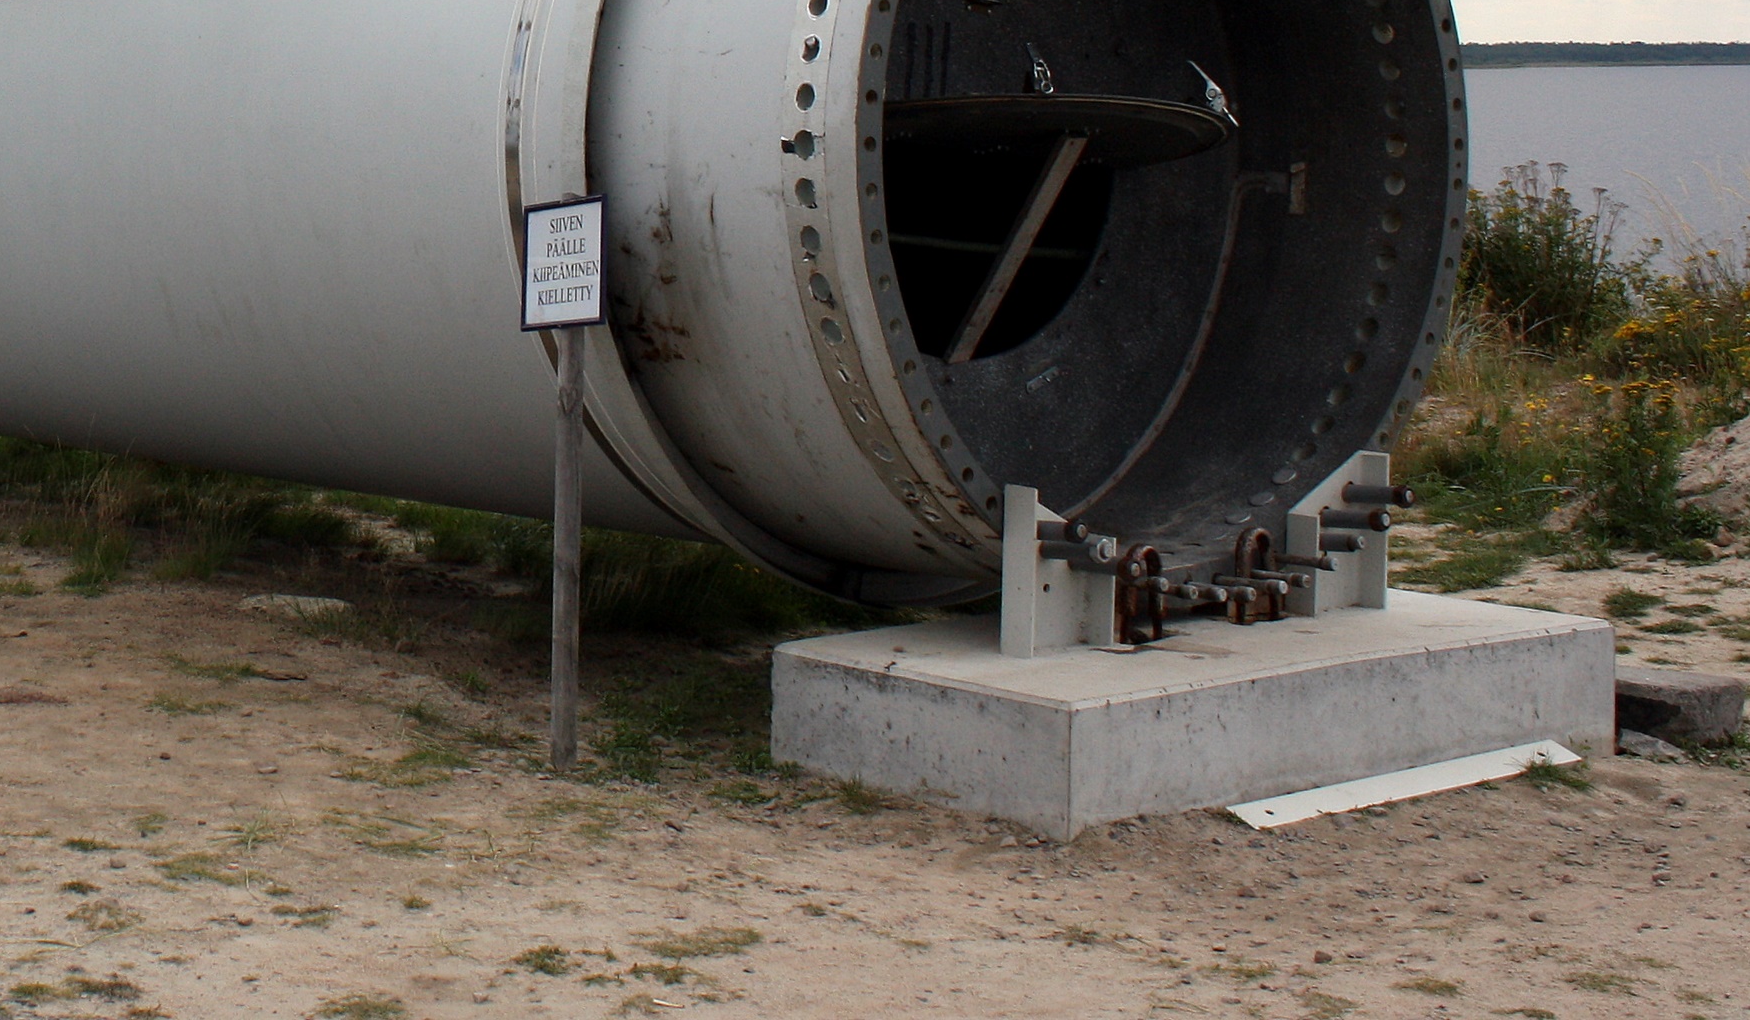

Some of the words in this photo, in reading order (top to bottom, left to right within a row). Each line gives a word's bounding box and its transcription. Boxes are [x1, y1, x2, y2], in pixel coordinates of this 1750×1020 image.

[550, 214, 583, 234] SIIVEN
[547, 237, 586, 257] PÄÄLLE
[533, 260, 599, 283] KIIPEÄMINEN
[538, 285, 593, 305] KIELLETTY
